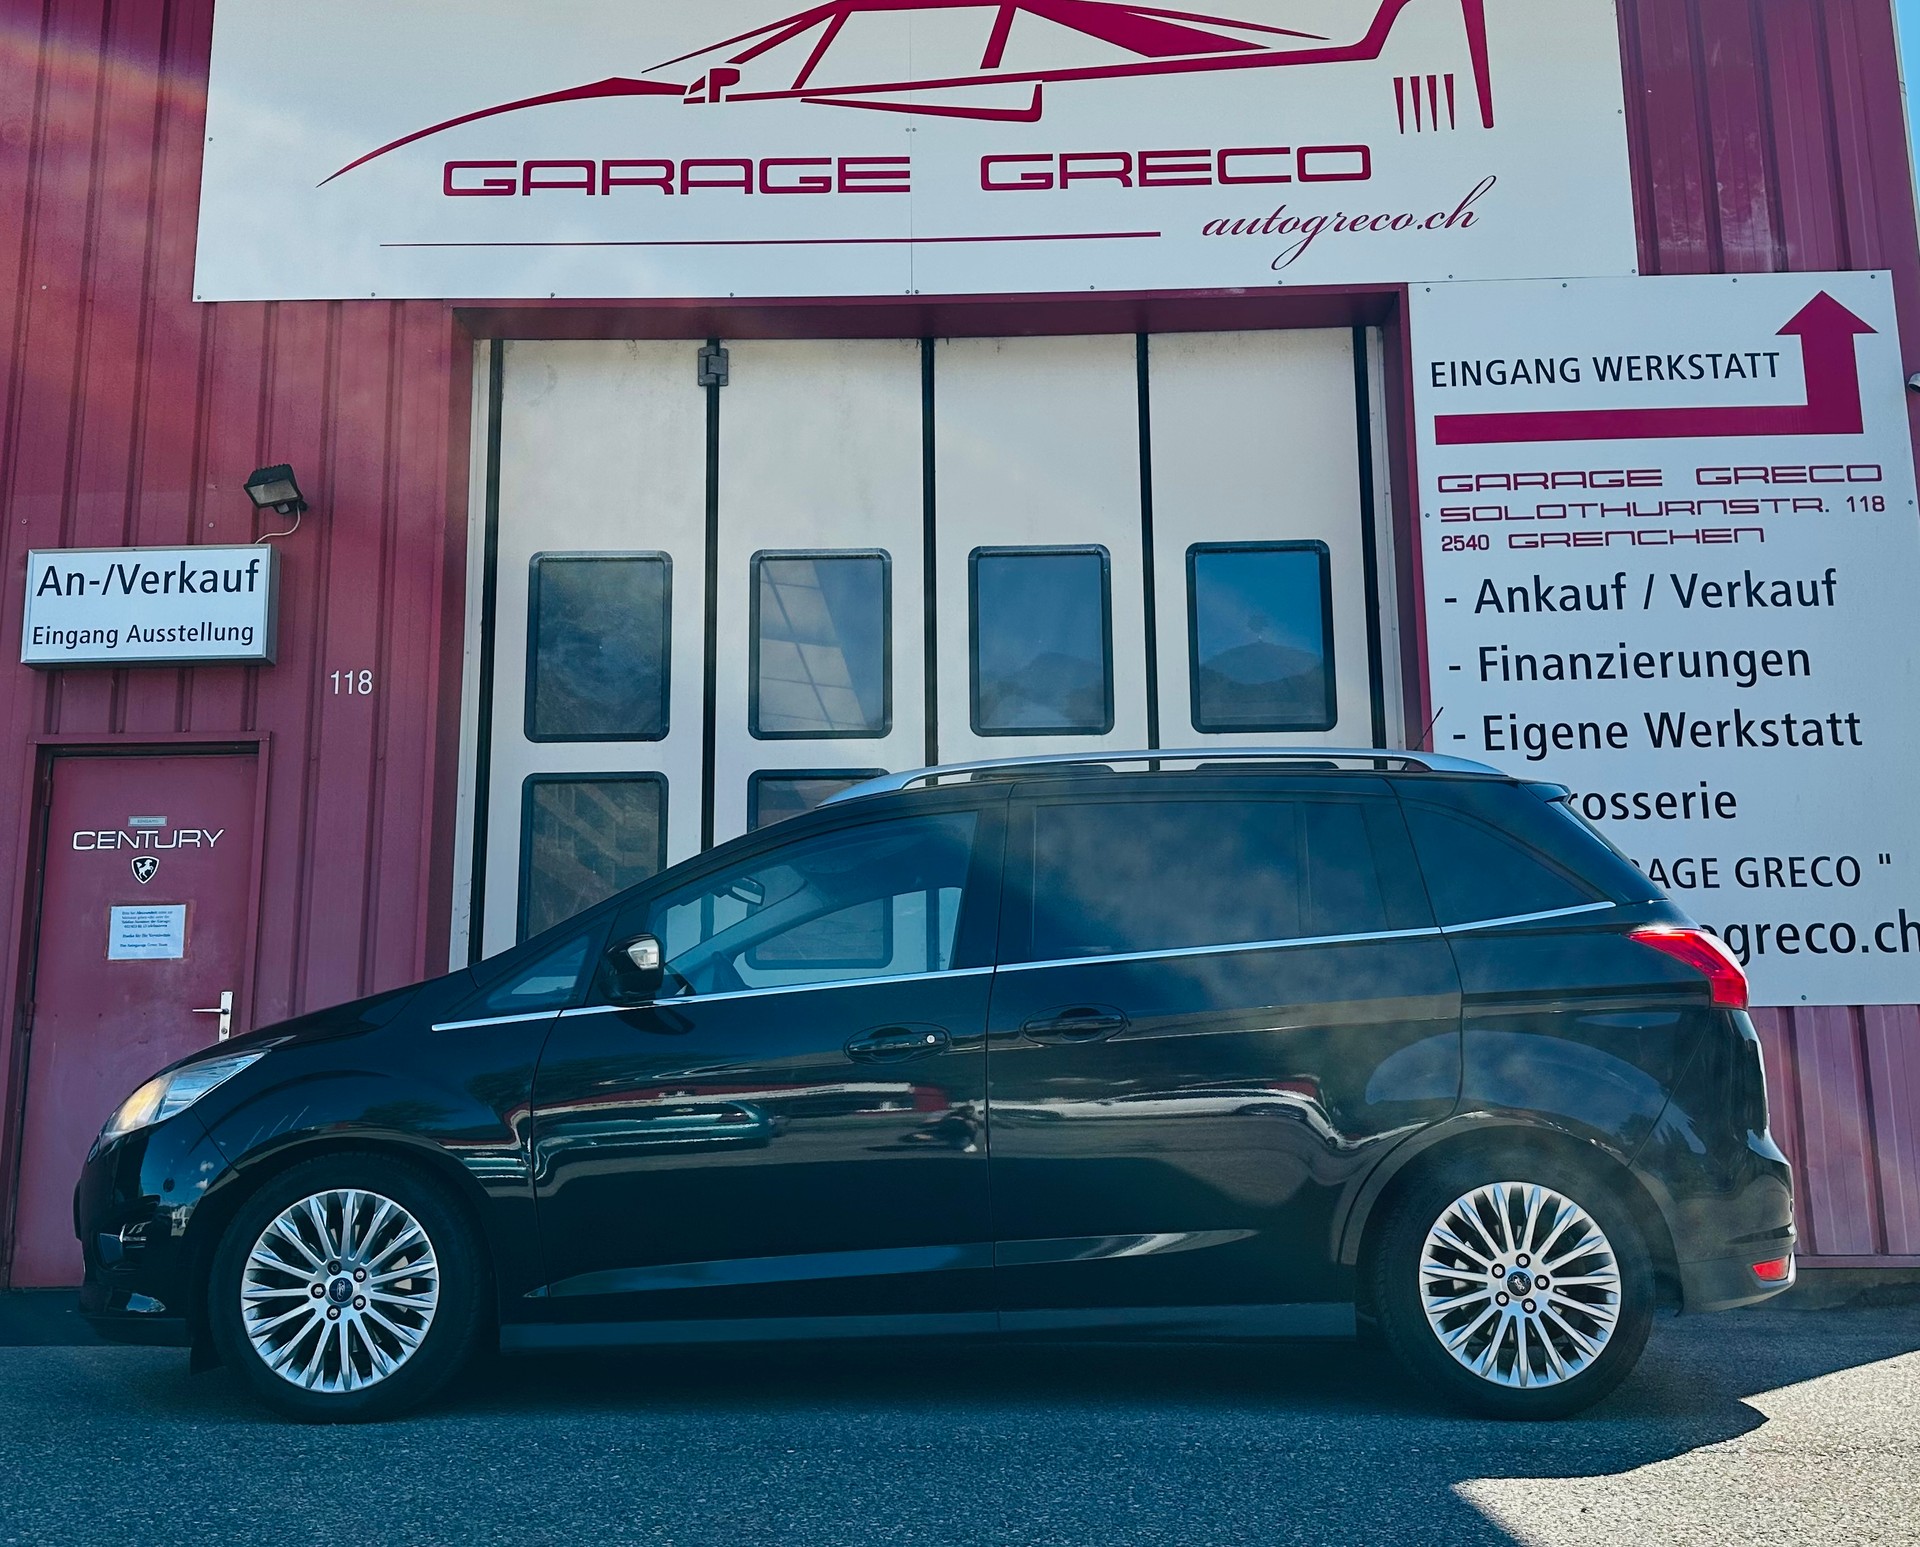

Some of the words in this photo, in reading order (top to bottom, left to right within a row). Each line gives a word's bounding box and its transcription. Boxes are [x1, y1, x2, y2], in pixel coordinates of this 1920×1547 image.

[444, 157, 910, 196] GARAGE
[981, 145, 1371, 191] GRECO
[1202, 175, 1497, 271] autogreco.ch
[1431, 358, 1580, 387] EINGANG
[1593, 353, 1779, 381] WERKSTATT
[1438, 469, 1662, 493] GARAGE
[1696, 465, 1882, 485] GRECO
[1441, 498, 1829, 522] SOLOTHURNSTR.
[1847, 496, 1885, 512] 118
[1442, 535, 1489, 551] 2540
[1509, 528, 1764, 548] GRENCHEN
[37, 559, 259, 596] An-/Verkauf
[1475, 572, 1626, 613] Ankauf
[1644, 574, 1654, 609] /
[1670, 568, 1836, 608] Verkauf
[33, 626, 118, 649] Eingang
[126, 622, 253, 645] Ausstellung
[331, 670, 372, 694] 118
[1479, 643, 1810, 687] Finanzierungen
[1484, 714, 1627, 761] Eigene
[1644, 709, 1862, 748] Werkstatt
[73, 830, 224, 849] CENTURY
[1631, 858, 1720, 888] AGE
[1735, 856, 1860, 888] GRECO
[1700, 908, 1920, 967] greco.ch
